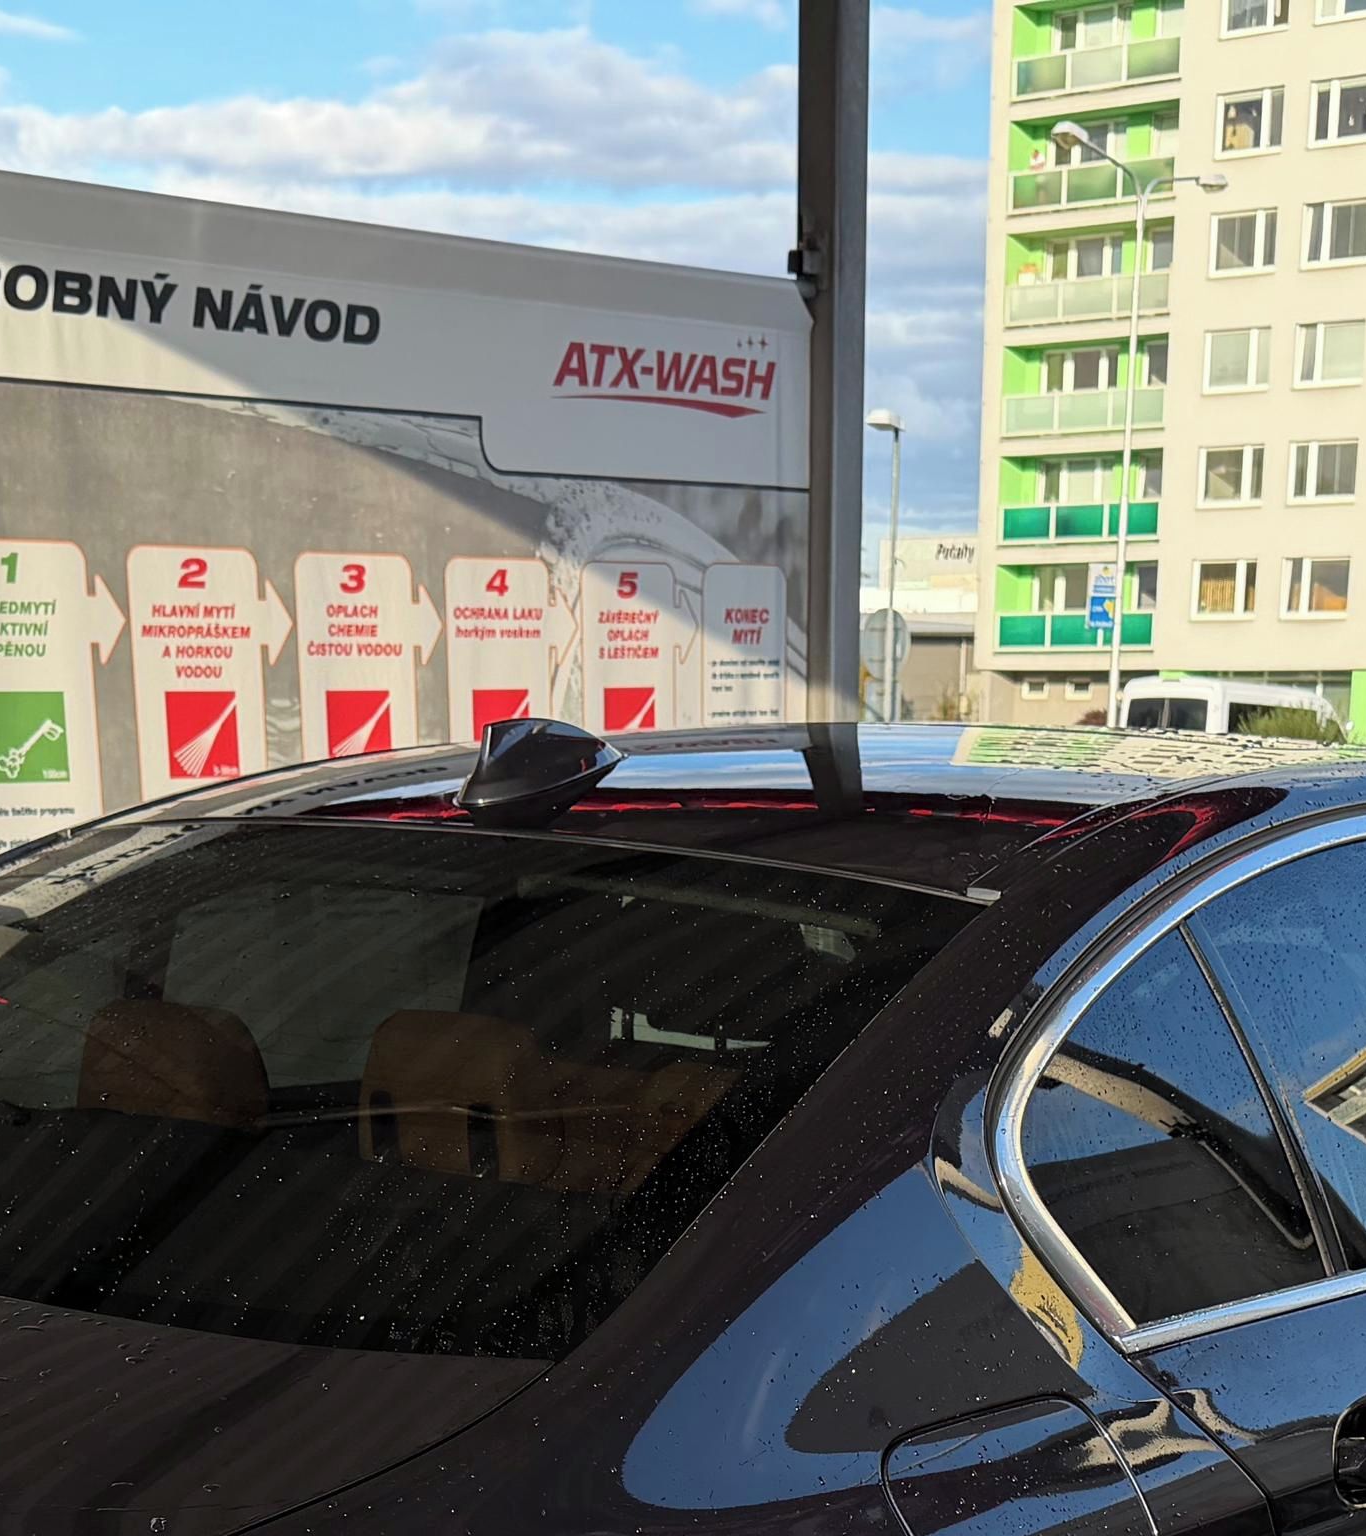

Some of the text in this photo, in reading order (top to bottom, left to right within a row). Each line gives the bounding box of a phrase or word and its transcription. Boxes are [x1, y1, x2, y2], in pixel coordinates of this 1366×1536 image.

[193, 284, 380, 345] NÁVOD
[553, 342, 776, 400] ATX-WASH
[0, 552, 18, 584] 1
[177, 558, 207, 589] 2
[340, 564, 365, 594] 3
[485, 569, 508, 596] 4
[617, 572, 638, 599] 5
[152, 603, 235, 619] HLAVNÍ MYTÍ
[327, 604, 377, 618] OPLACH
[454, 607, 542, 620] OCHRANA LAKU
[724, 608, 769, 624] KONEC
[142, 624, 250, 638] MIKROPRÁŠKEM
[328, 624, 377, 637] CHEMIE
[176, 646, 232, 659] HORKOU
[308, 642, 402, 657] ČISTOU VODOU
[176, 666, 222, 678] VODOU
